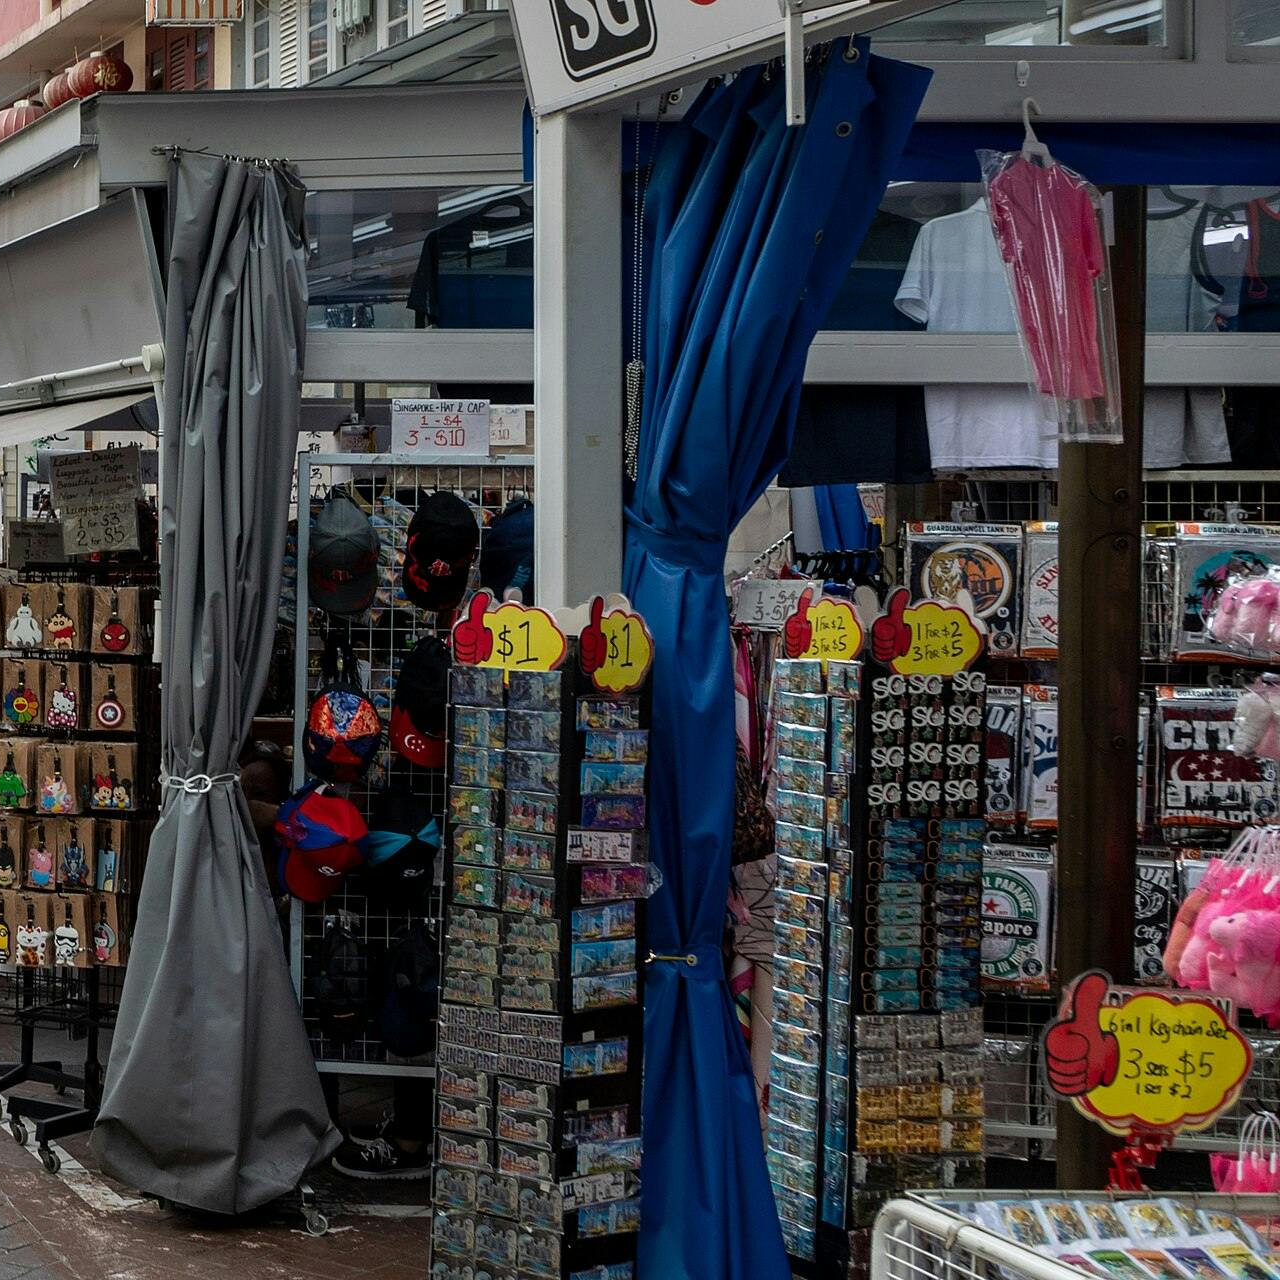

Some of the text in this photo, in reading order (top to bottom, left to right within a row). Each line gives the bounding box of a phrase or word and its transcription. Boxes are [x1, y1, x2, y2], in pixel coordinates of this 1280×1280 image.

[466, 402, 485, 413] CAP
[404, 429, 419, 446] 3
[926, 523, 1019, 534] GUARDIAN ANGEL TANK TOP
[1202, 526, 1238, 534] GUARDIAN
[832, 616, 846, 631] $2
[916, 621, 962, 640] 1 $2
[497, 622, 539, 665] $1
[607, 624, 633, 669] $1
[811, 636, 847, 656] 3 $5
[912, 640, 963, 661] 3 $5
[993, 850, 1050, 860] ANGEL TANK TOP
[1124, 1048, 1215, 1083] 3 $5
